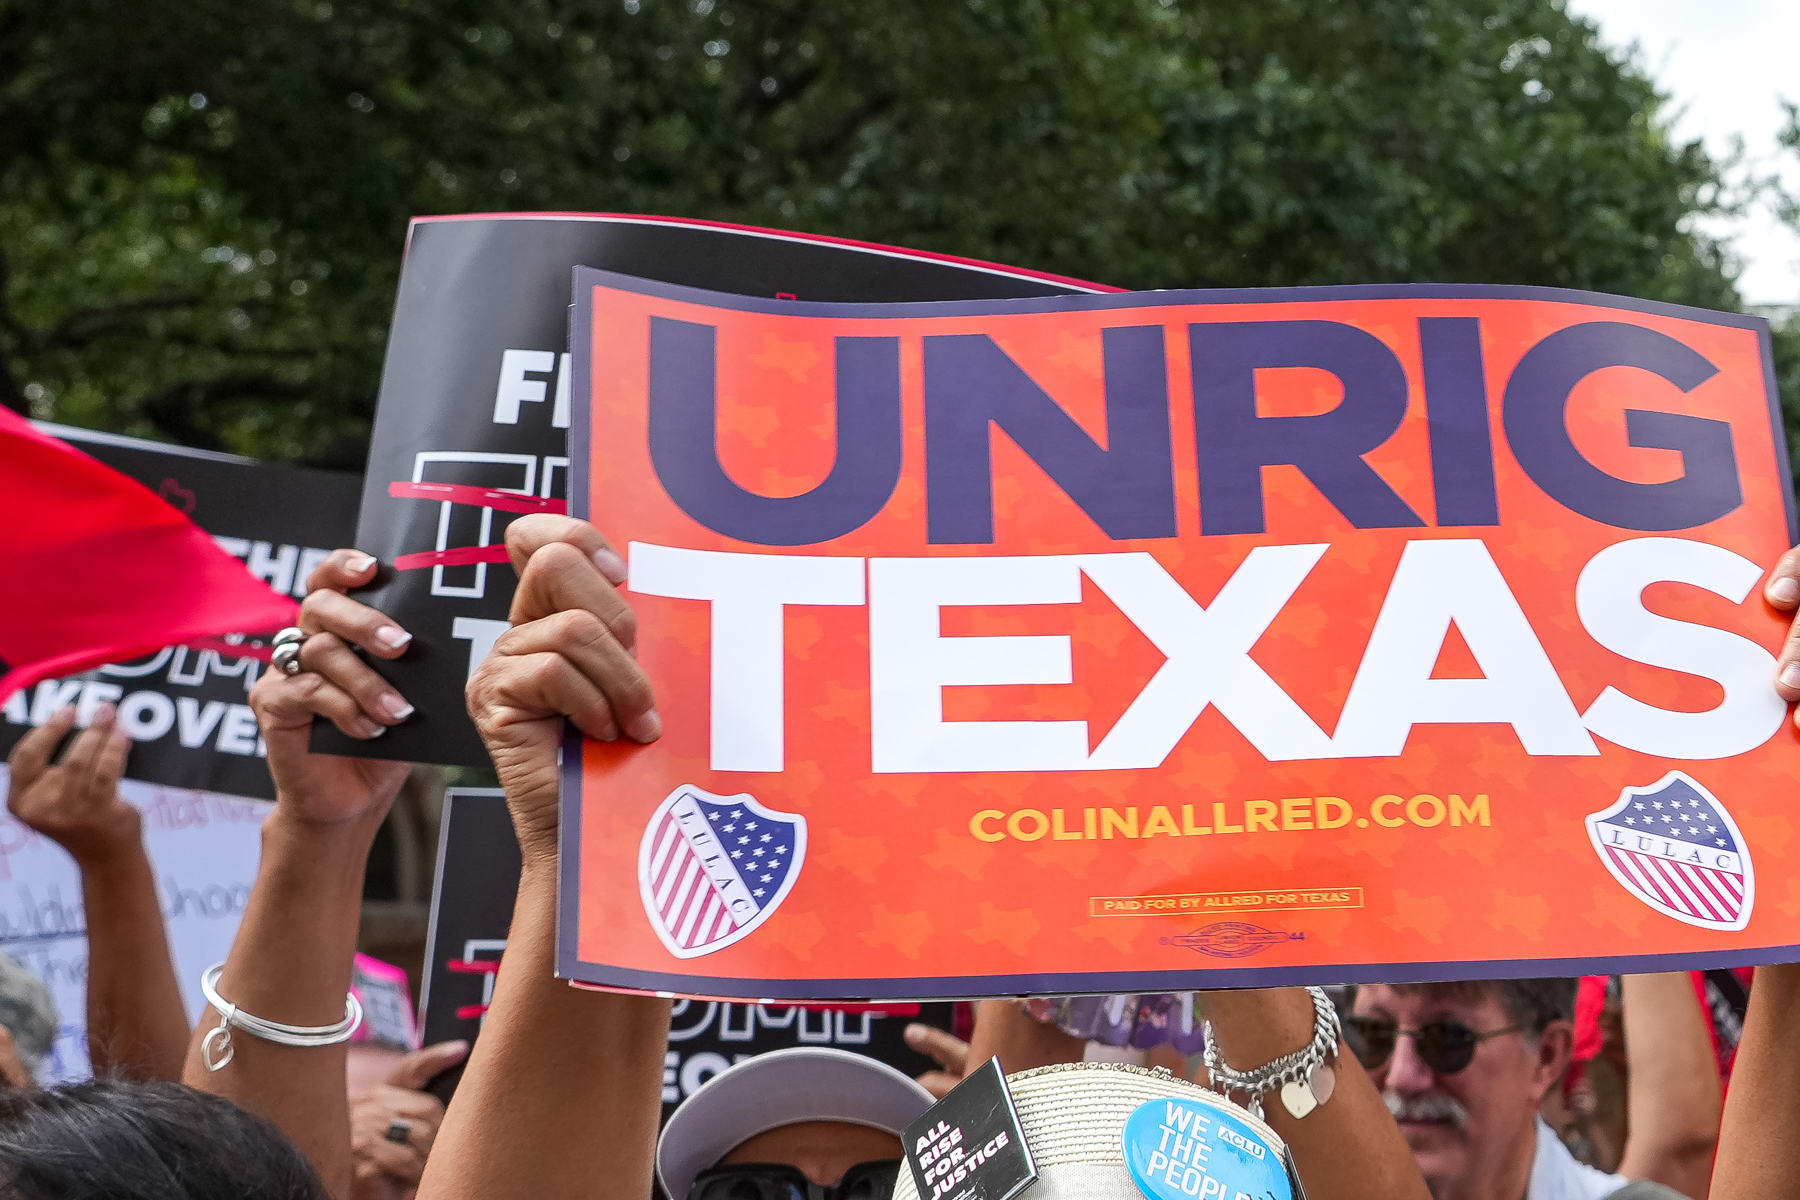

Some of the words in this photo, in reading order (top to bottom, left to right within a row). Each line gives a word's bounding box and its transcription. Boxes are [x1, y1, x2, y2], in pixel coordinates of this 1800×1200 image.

[648, 315, 1743, 546] UNRIG
[627, 537, 1788, 773] TEXAS
[969, 792, 1491, 843] COLINALLRED.COM
[680, 809, 751, 913] LULAC
[1611, 830, 1732, 869] LULAC
[1104, 900, 1142, 911] PAID
[1143, 898, 1177, 910] FOR
[1180, 897, 1202, 909] BY
[1204, 895, 1263, 908] ALLRED
[1266, 893, 1298, 905] FOR
[1299, 892, 1351, 904] TEXAS
[916, 1120, 950, 1155] ALL
[1166, 1101, 1211, 1143] WE
[1221, 1129, 1263, 1157] ACLU
[919, 1127, 963, 1170] RISE
[924, 1147, 966, 1186] FOR
[1159, 1124, 1213, 1173] THE
